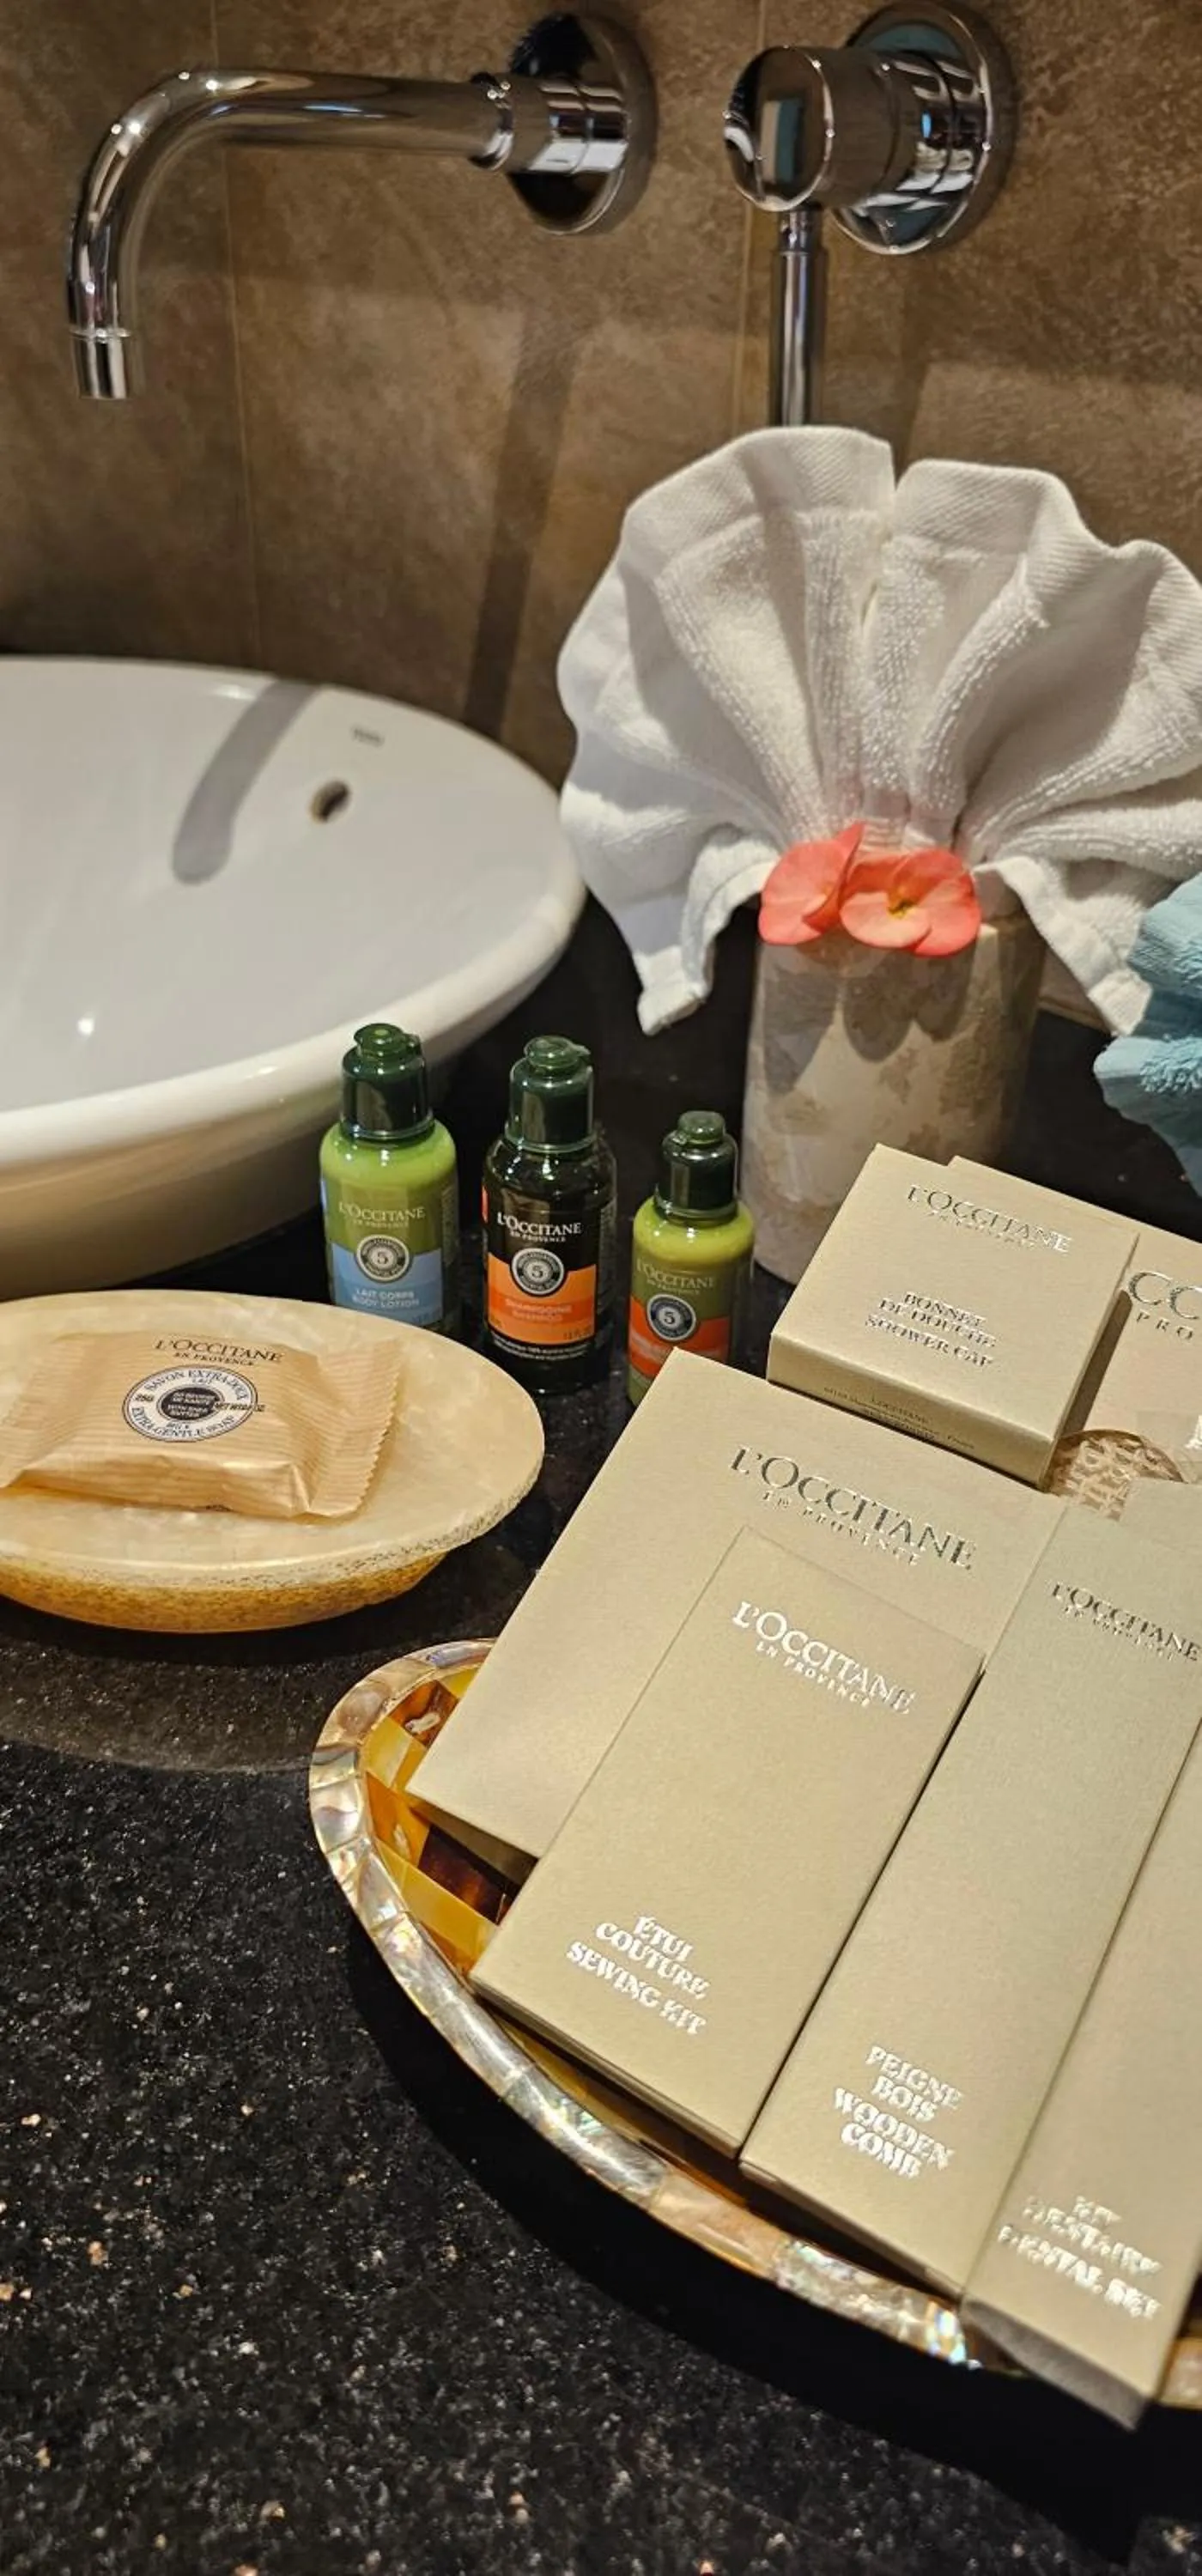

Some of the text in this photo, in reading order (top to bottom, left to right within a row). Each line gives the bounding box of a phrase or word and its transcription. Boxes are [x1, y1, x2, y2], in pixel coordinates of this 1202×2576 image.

[339, 1202, 426, 1222] L'OCCITANE
[497, 1212, 582, 1236] L'OCCITANE
[908, 1184, 1072, 1254] L'OCCITANE
[378, 1252, 388, 1265] 5
[531, 1265, 543, 1279] 5
[636, 1258, 714, 1289] L'OCCITANE
[352, 1295, 420, 1309] BODY LOTION
[664, 1311, 676, 1325] 5
[879, 1297, 997, 1347] DE DOUCHE
[904, 1291, 986, 1327] BONNET
[155, 1340, 283, 1364] L'OCCITANE
[191, 1353, 255, 1367] PROVENCE
[865, 1314, 994, 1367] SHOWER CAP
[144, 1371, 185, 1391] SAVON
[729, 1444, 976, 1571] L'OCCITANE
[1051, 1582, 1202, 1662] L'OCCITANE
[732, 1601, 917, 1715] L'OCCITANE
[756, 1641, 871, 1708] EN PROVENCE
[596, 1922, 711, 2000] COUTURE
[566, 1941, 707, 2034] SEWING KIT
[865, 2045, 964, 2110] PEIGNE
[871, 2075, 938, 2122] BOIS
[835, 2087, 955, 2170] WOODEN
[841, 2122, 922, 2178] COMB
[998, 2225, 1103, 2294] DENTAL
